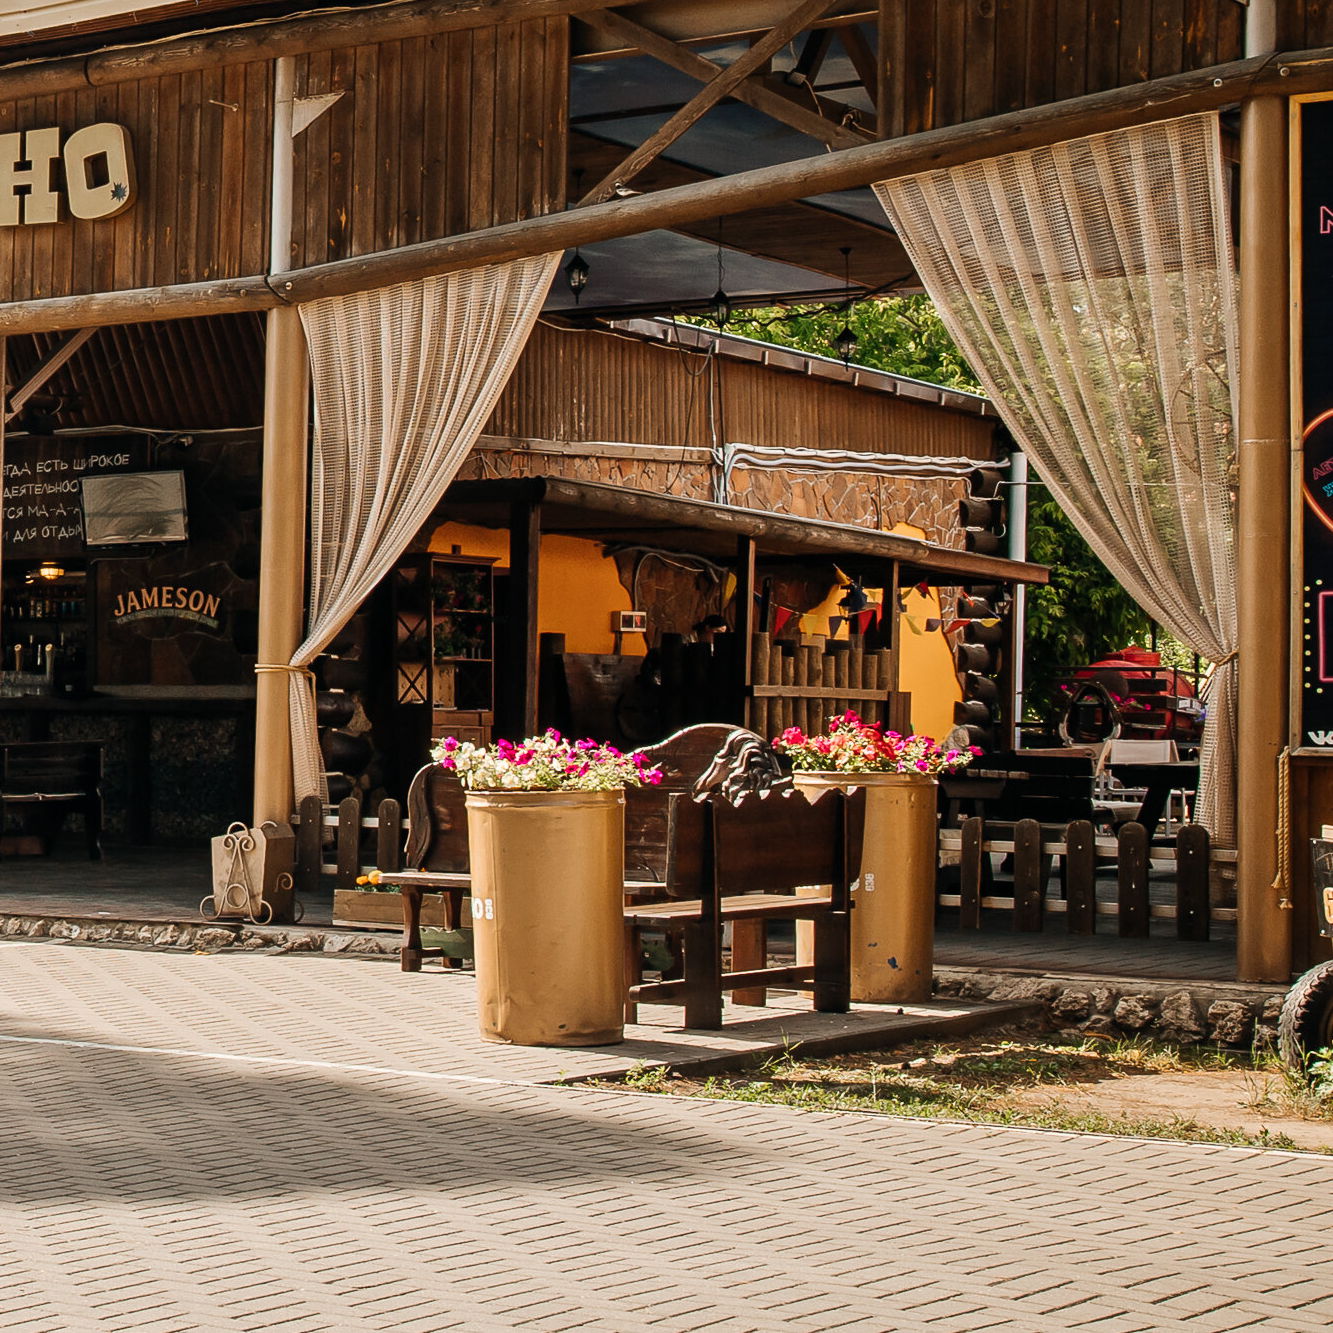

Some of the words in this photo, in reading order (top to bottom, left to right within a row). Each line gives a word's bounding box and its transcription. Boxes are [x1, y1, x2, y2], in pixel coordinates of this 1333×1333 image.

[36, 459, 68, 473] ЕСТЬ
[73, 453, 130, 470] ШИРОКОЕ
[13, 527, 37, 543] ДЛЯ
[114, 586, 221, 618] JAMESON
